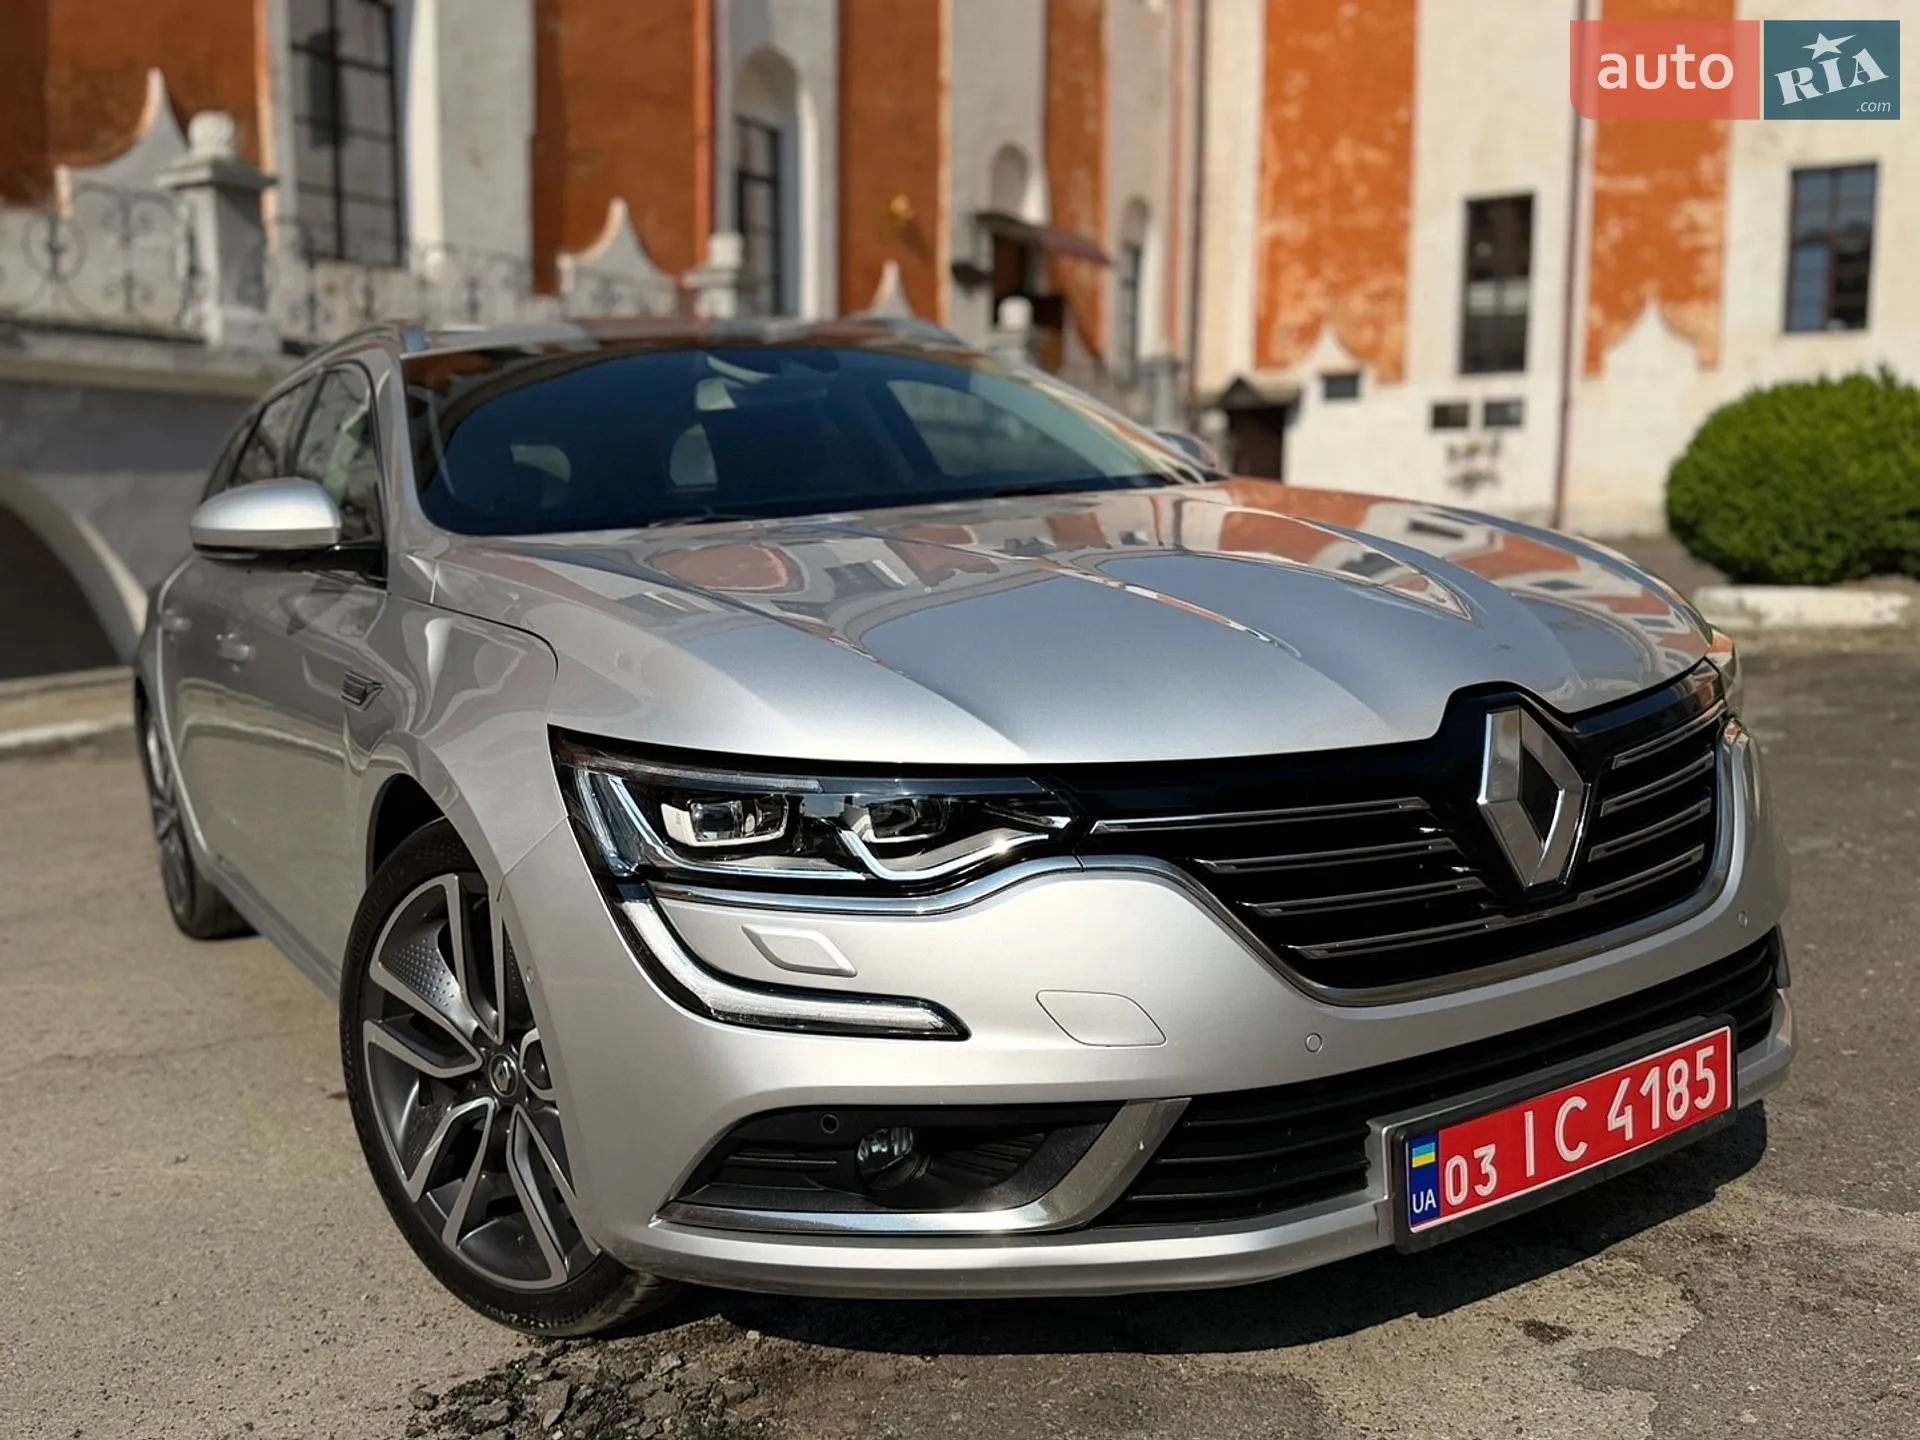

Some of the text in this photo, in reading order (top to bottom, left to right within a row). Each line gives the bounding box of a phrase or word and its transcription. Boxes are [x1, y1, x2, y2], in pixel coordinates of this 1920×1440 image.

[1445, 1143, 1498, 1206] 03
[1607, 1045, 1717, 1141] 4185
[1412, 1189, 1437, 1214] UA
